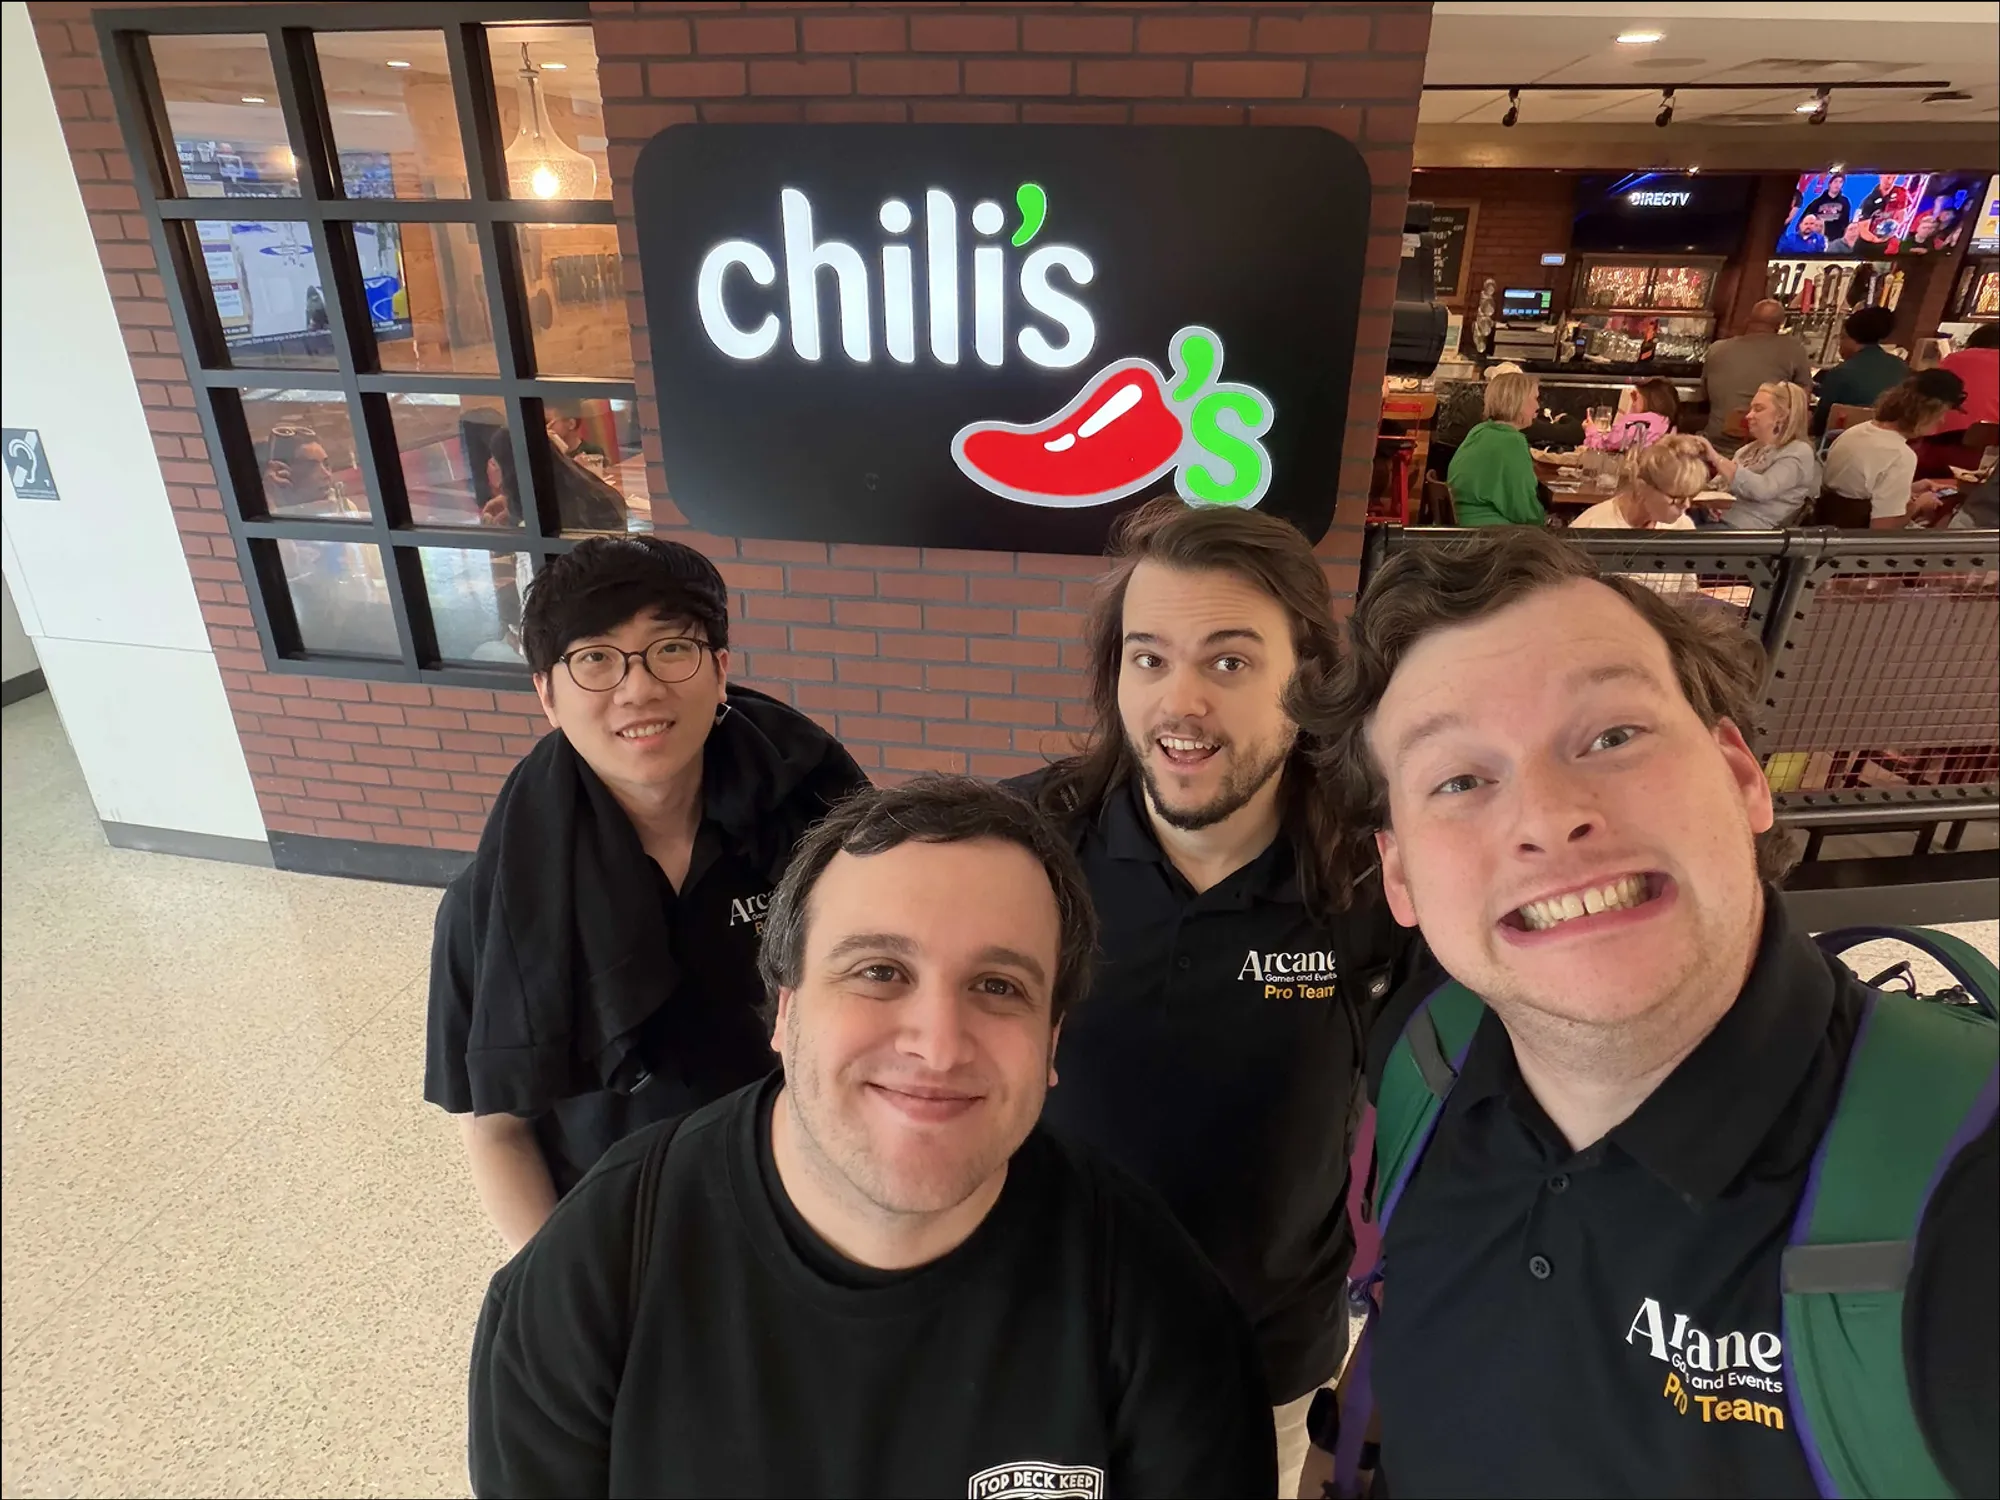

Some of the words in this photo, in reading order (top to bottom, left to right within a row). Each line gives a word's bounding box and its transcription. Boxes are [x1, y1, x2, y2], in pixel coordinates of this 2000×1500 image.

[1628, 191, 1691, 207] DIRECTV
[697, 182, 1096, 368] chili's
[1237, 949, 1336, 982] Arcane
[1264, 973, 1295, 983] Games
[1296, 972, 1312, 982] and
[1264, 984, 1294, 1000] Pro
[1691, 1374, 1724, 1390] and
[1728, 1372, 1784, 1393] Events
[1663, 1371, 1688, 1415] Pro
[1694, 1394, 1785, 1431] Team
[978, 1474, 1010, 1497] TOP
[1013, 1471, 1056, 1488] DECK
[1059, 1474, 1094, 1489] KEEP
